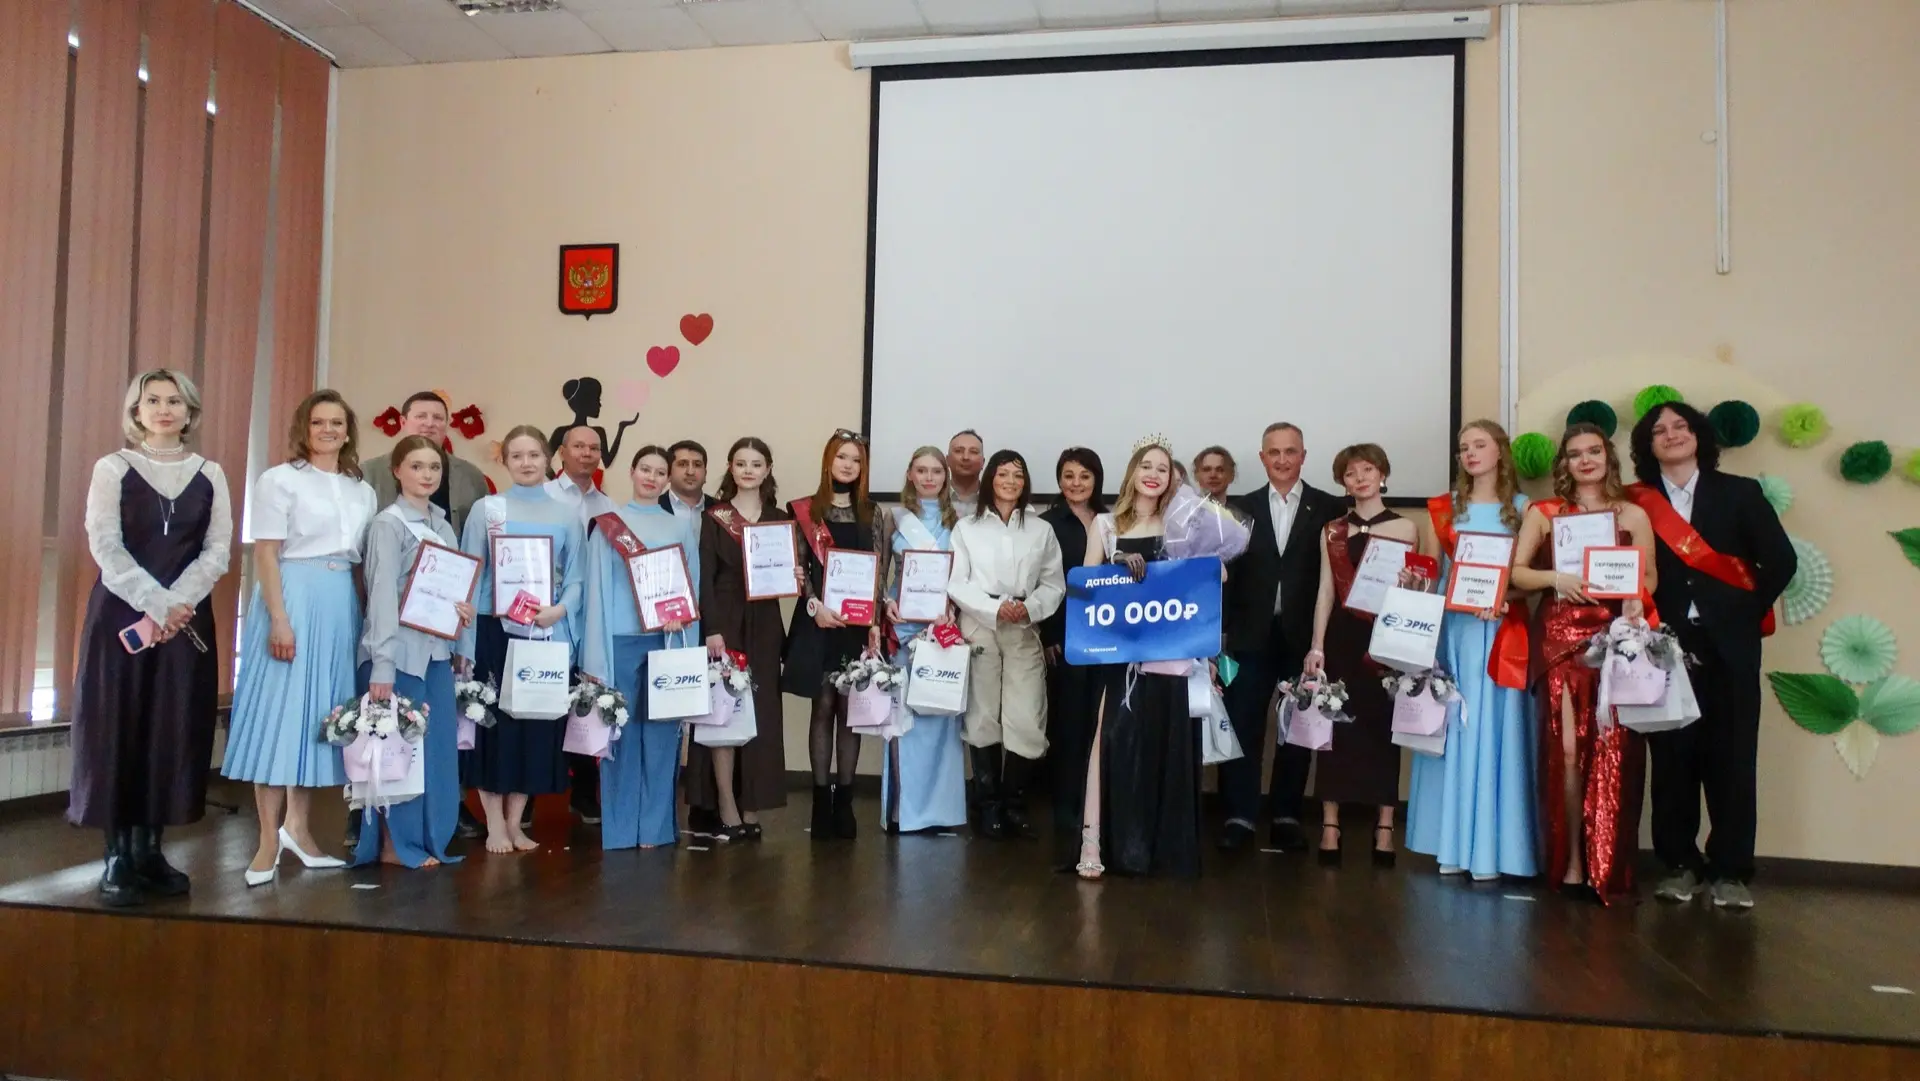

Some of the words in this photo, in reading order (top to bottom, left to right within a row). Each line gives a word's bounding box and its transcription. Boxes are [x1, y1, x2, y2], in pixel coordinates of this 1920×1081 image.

[1085, 574, 1136, 588] датабан
[1085, 603, 1115, 626] 10
[1404, 618, 1436, 633] ЭРИС
[537, 670, 564, 680] ЭРИС
[674, 674, 702, 685] ЭРИС
[935, 669, 961, 680] ЭРИС
